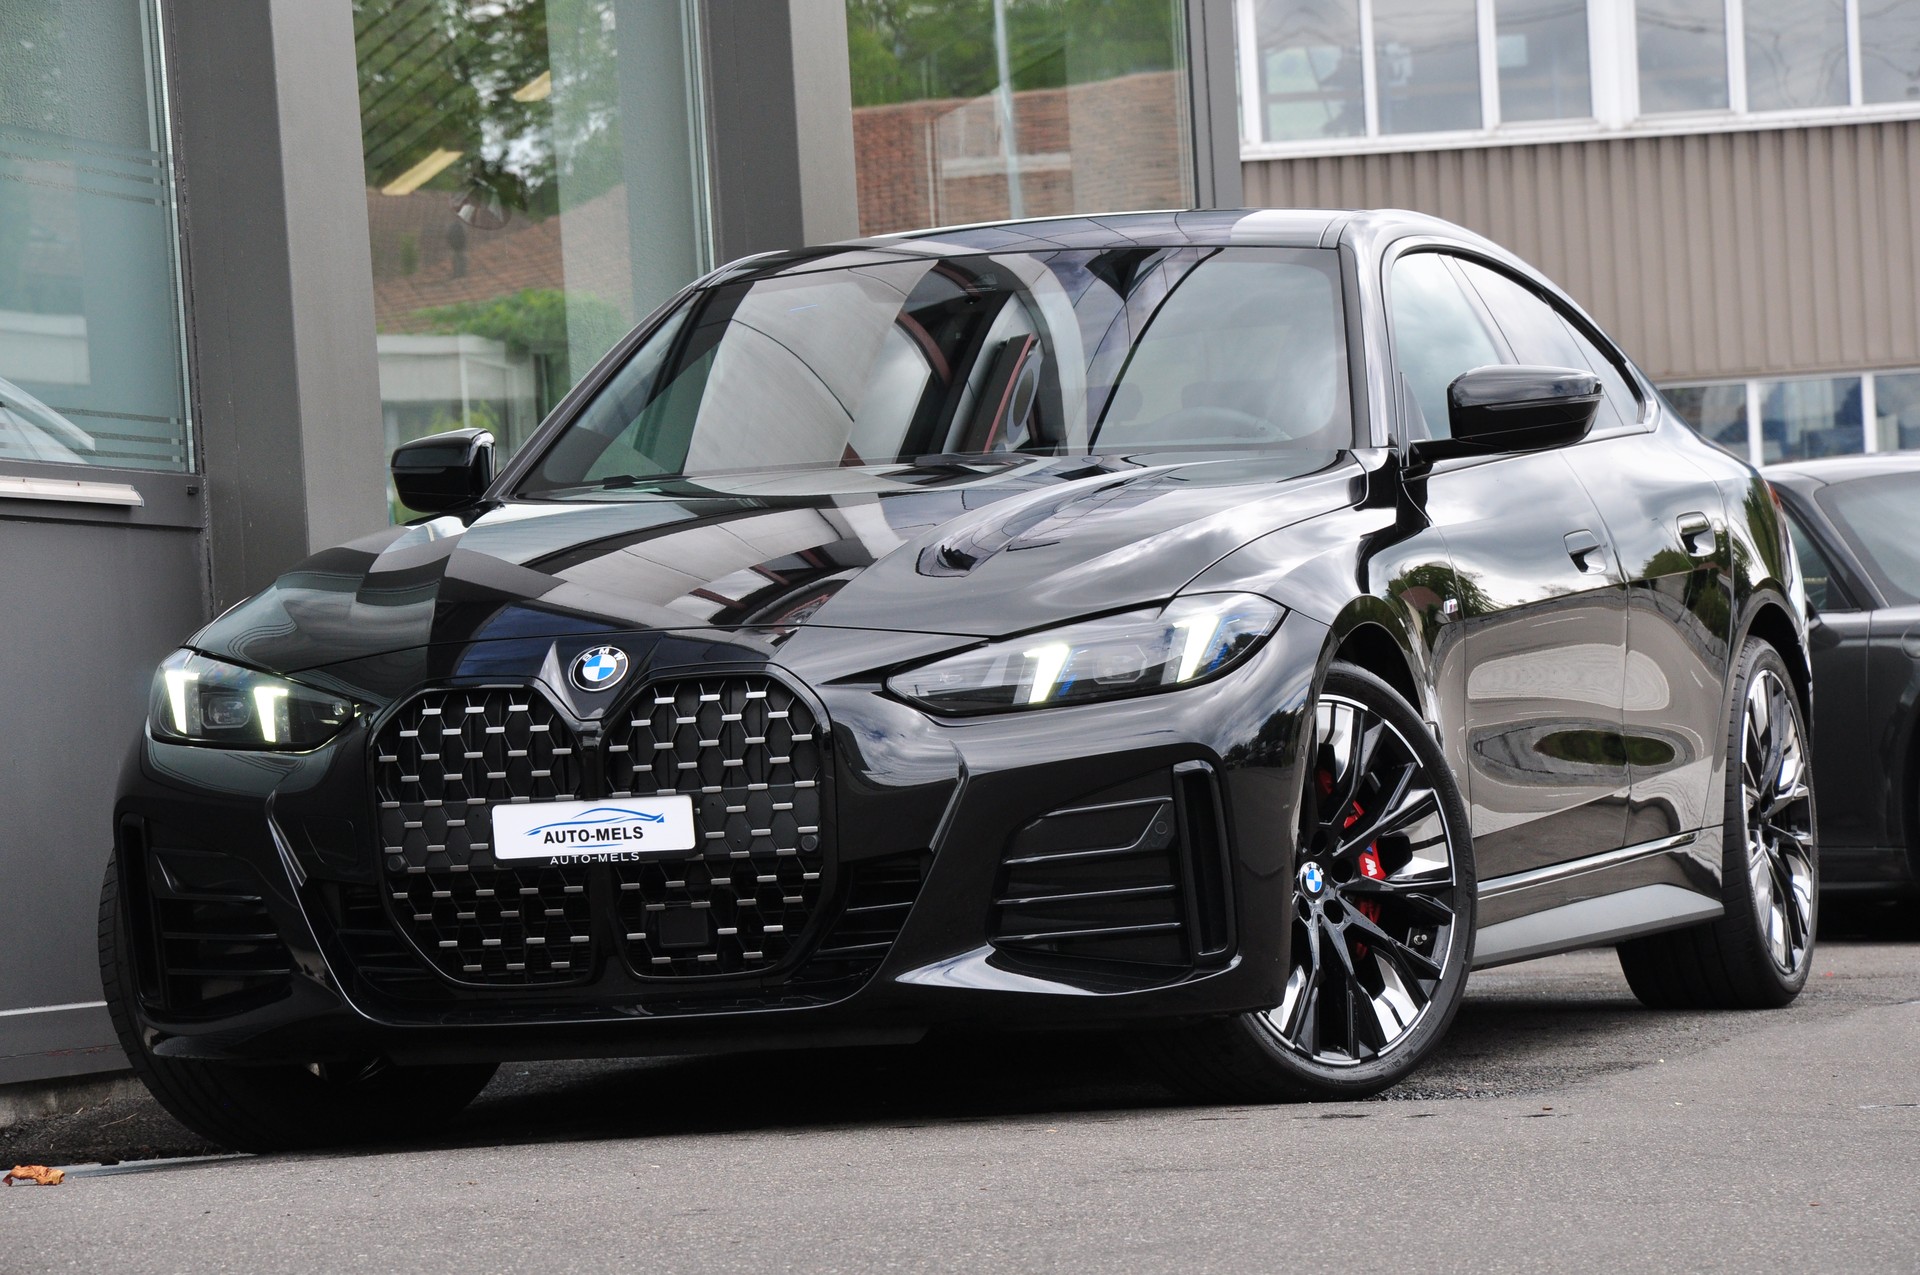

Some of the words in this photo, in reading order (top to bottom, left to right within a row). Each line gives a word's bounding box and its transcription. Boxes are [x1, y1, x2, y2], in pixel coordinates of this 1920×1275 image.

[582, 647, 625, 662] BMW
[543, 826, 644, 845] AUTO-MELS
[549, 851, 641, 865] AUTO-MELS
